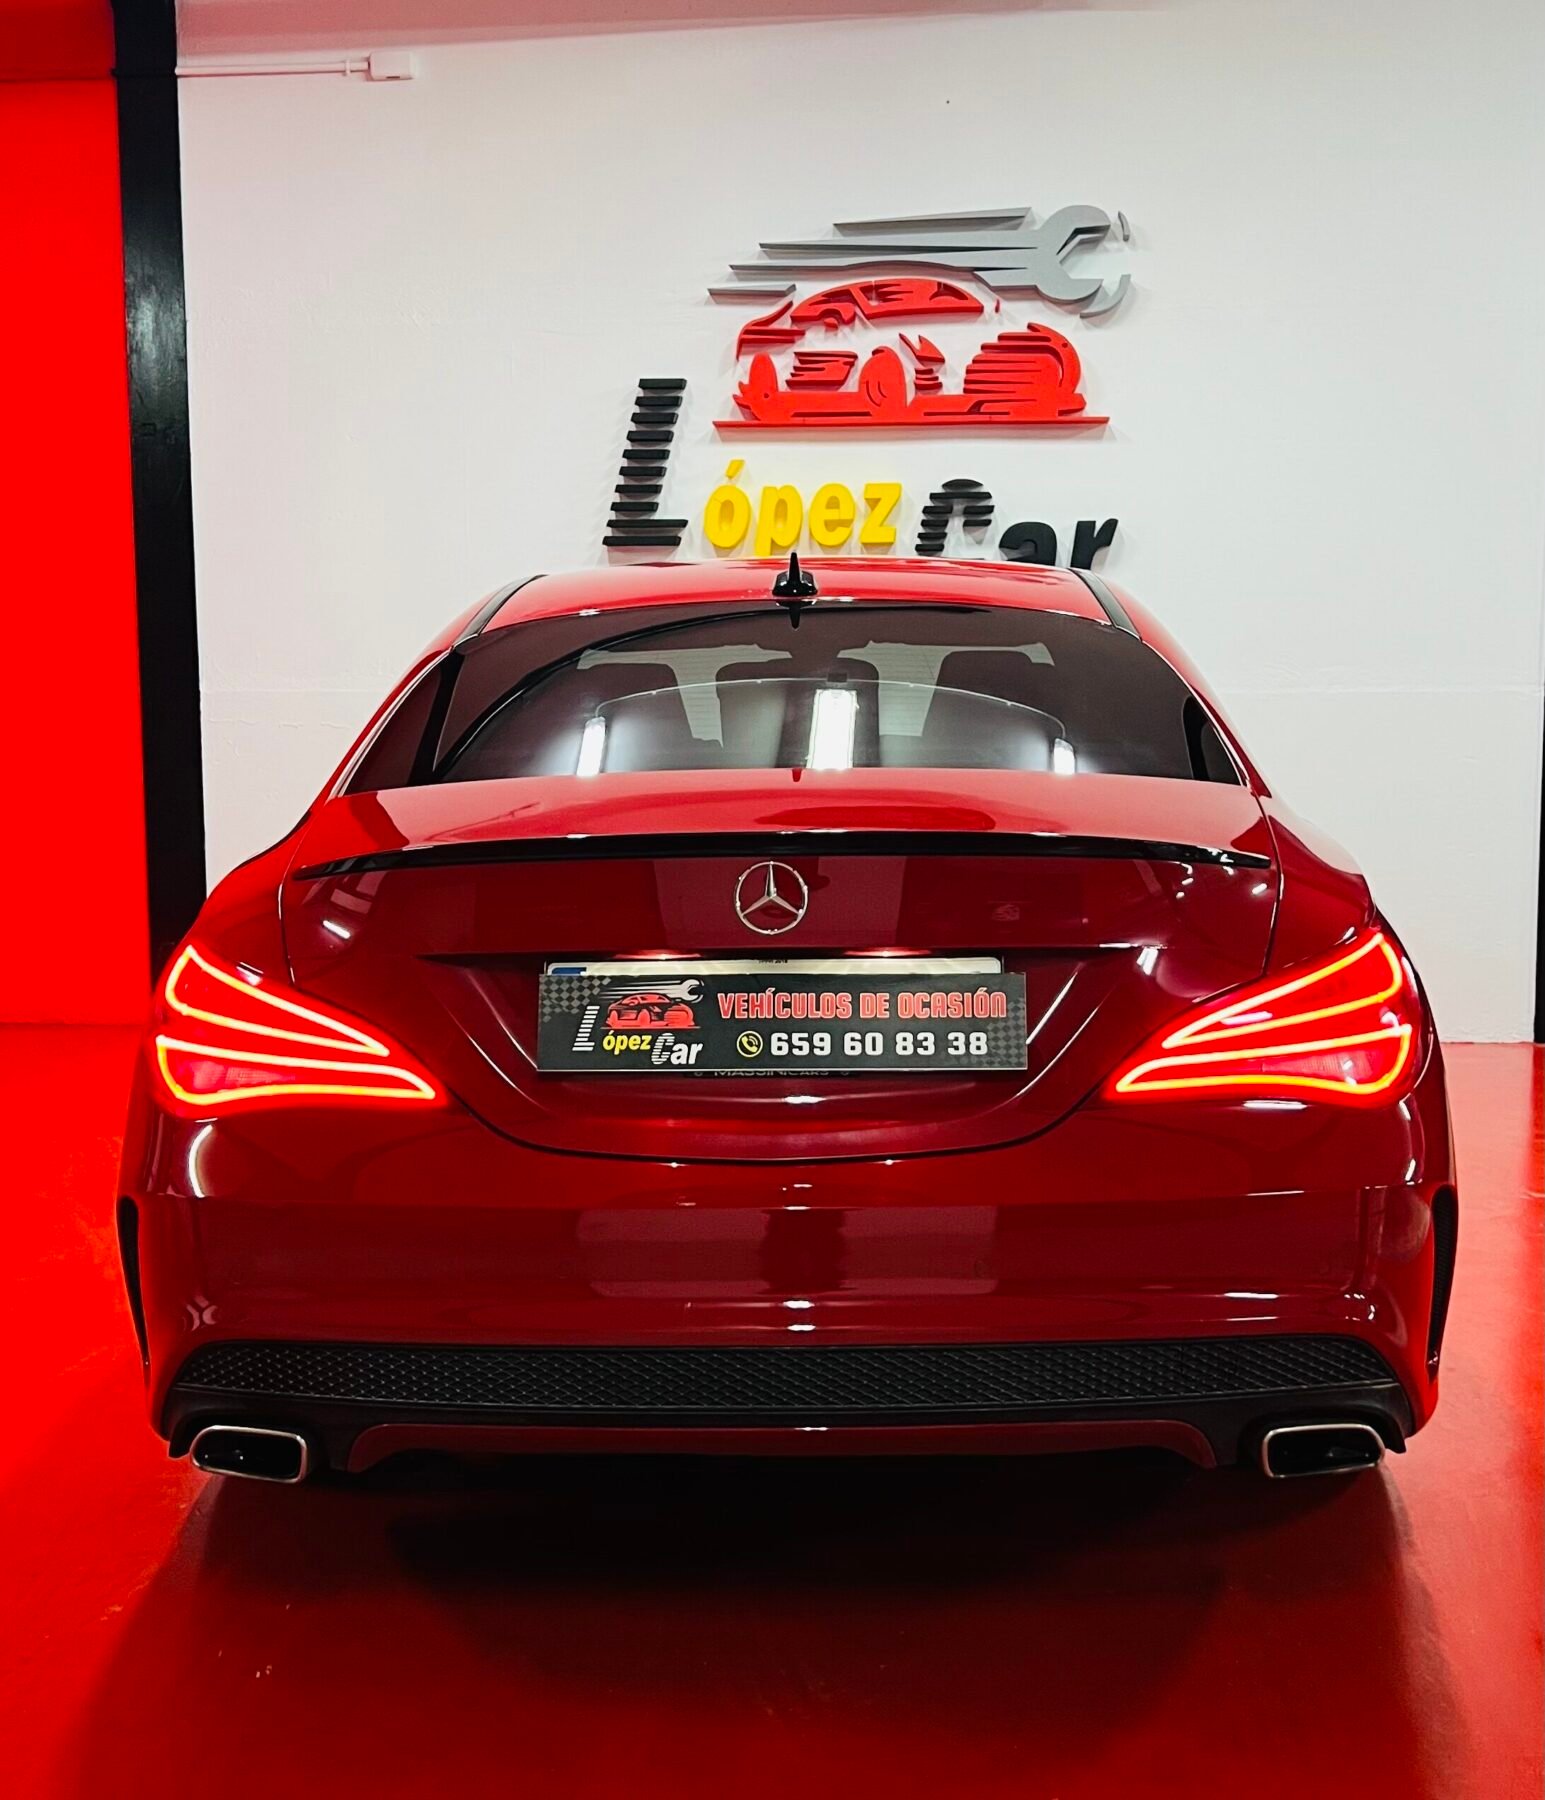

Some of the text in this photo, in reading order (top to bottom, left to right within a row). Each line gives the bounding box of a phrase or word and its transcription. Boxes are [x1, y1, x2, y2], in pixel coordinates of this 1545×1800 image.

[602, 378, 902, 556] López
[717, 987, 1007, 1019] VEHÍCULOS DE OCASIÓN
[572, 1005, 703, 1065] López Car
[770, 1031, 988, 1056] 659 60 83 38
